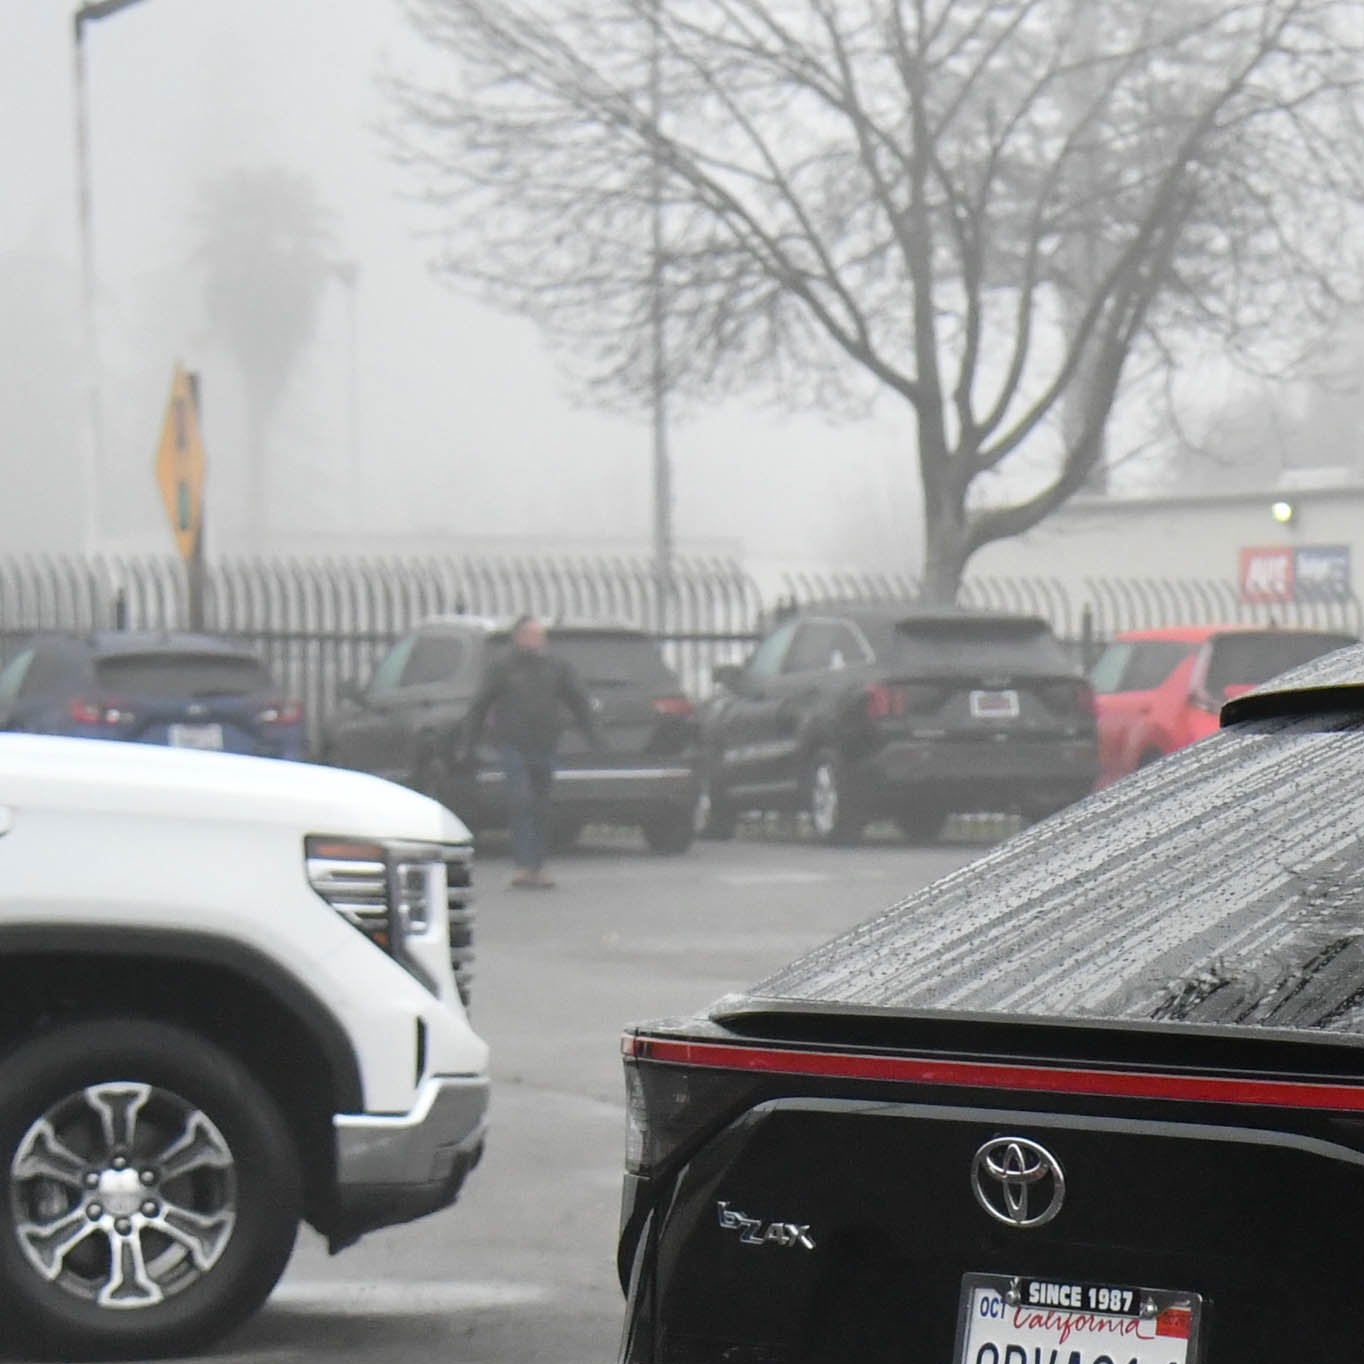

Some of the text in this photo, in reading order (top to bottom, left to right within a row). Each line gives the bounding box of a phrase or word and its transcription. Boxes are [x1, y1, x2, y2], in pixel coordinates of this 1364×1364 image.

[1029, 1282, 1133, 1311] SINCE 1987
[1013, 1307, 1155, 1344] California
